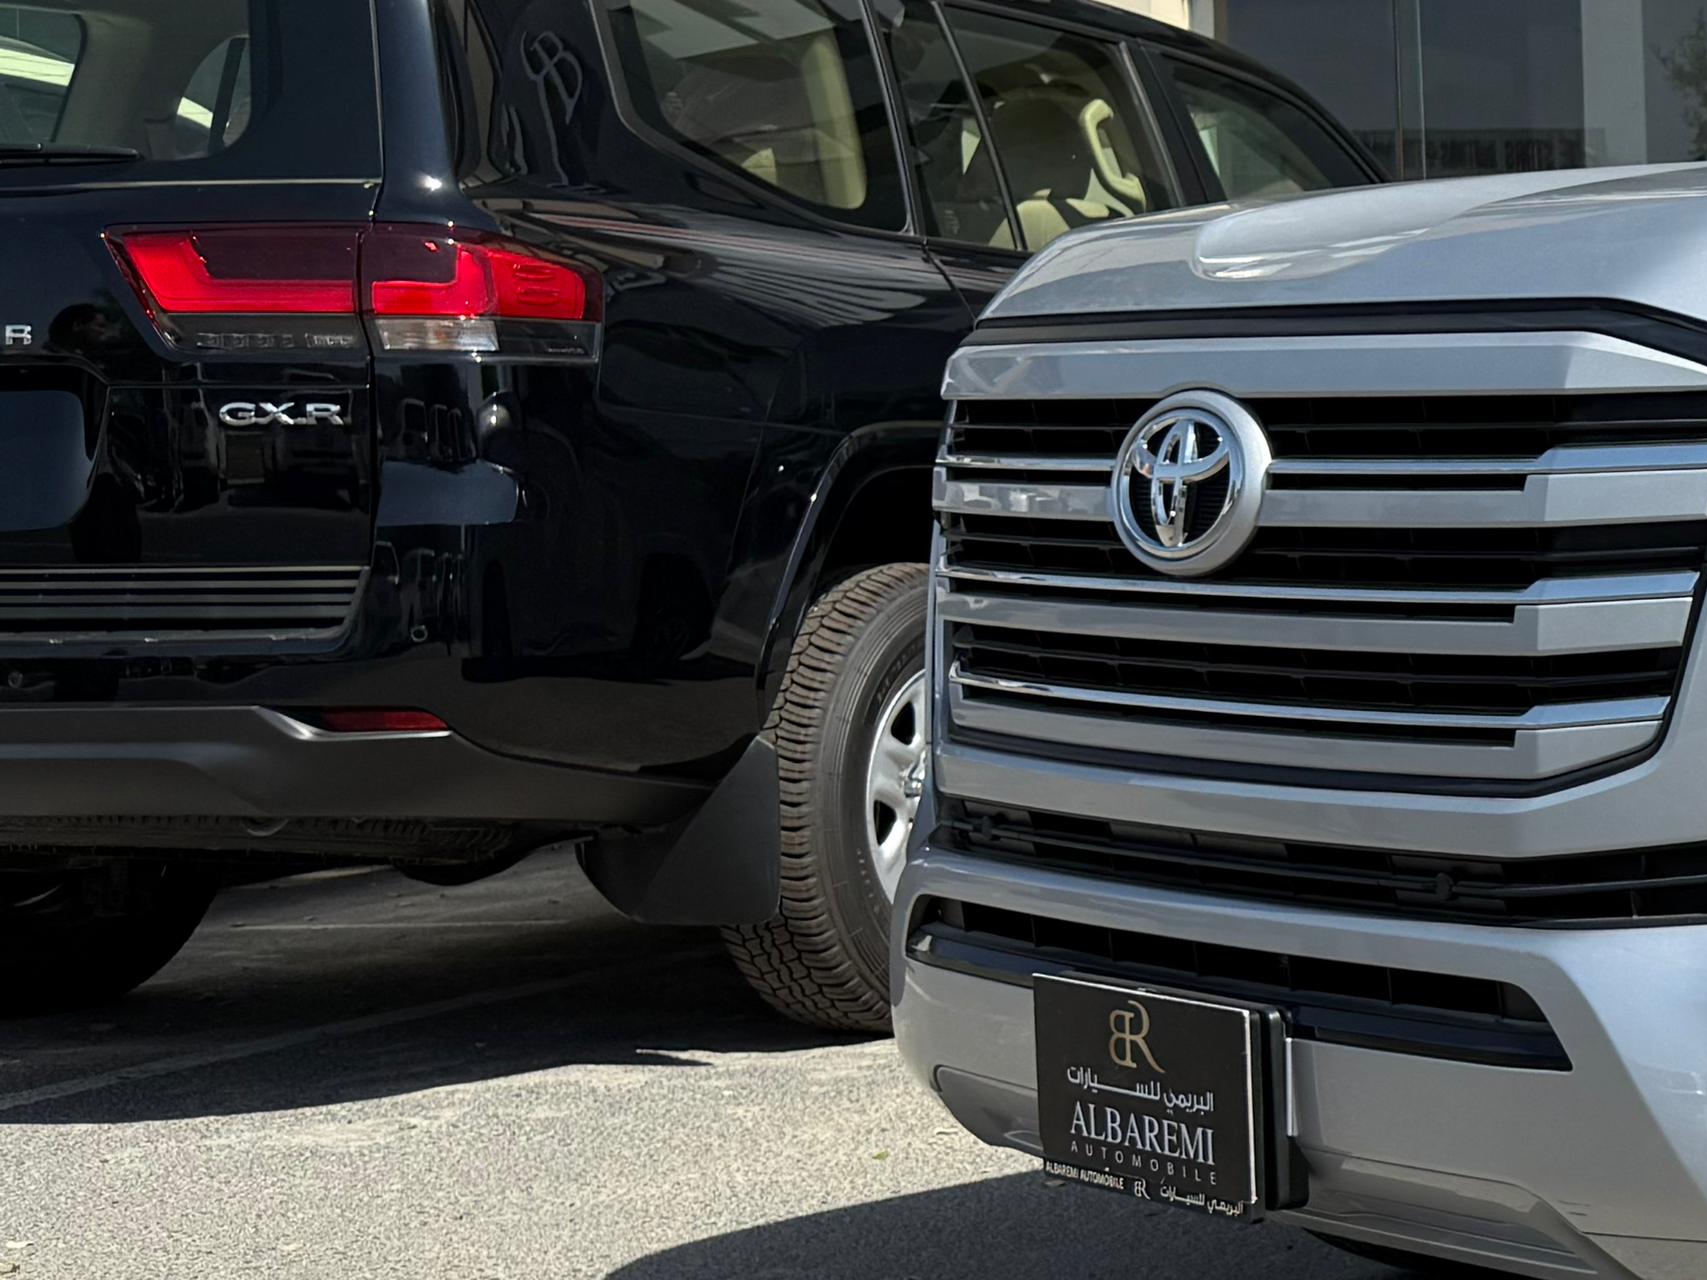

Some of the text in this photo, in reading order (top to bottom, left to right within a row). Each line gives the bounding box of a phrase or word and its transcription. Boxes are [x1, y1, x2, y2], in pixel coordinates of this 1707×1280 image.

[218, 401, 345, 426] GXR
[1163, 1091, 1214, 1116] البريمي
[1070, 1101, 1216, 1166] ALBAREMI
[1046, 1161, 1124, 1190] ALBAREMI AUTOMOBILE
[1070, 1140, 1217, 1185] AUTOMOBILE
